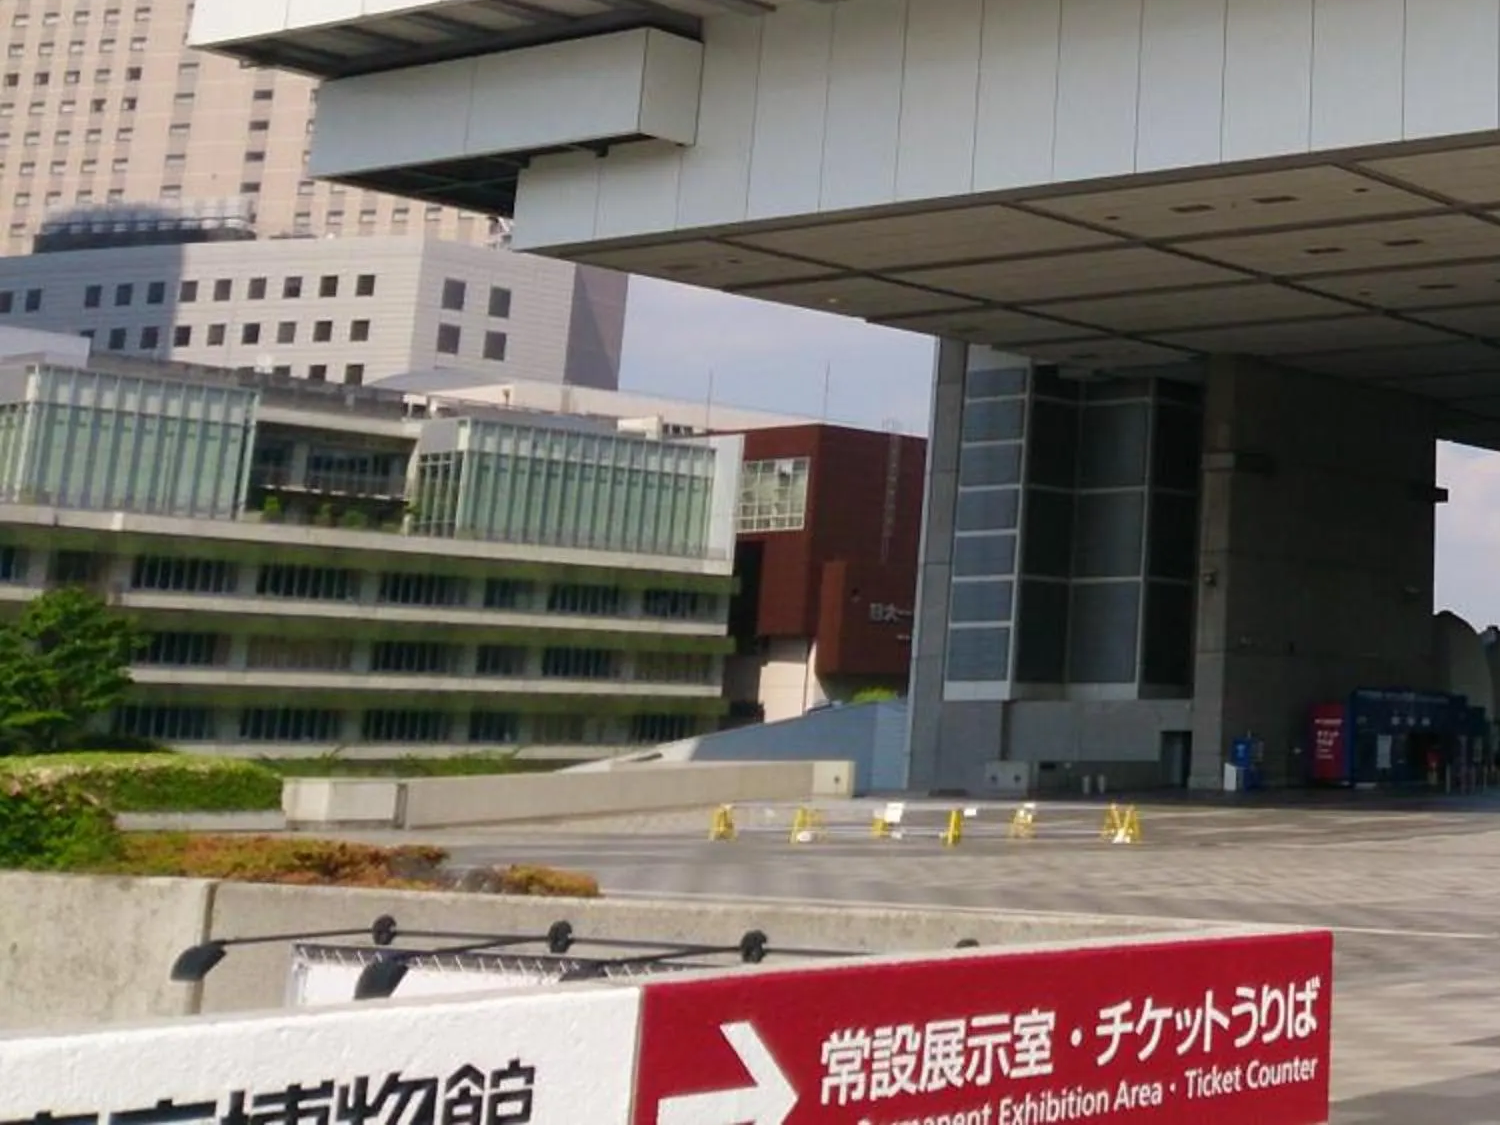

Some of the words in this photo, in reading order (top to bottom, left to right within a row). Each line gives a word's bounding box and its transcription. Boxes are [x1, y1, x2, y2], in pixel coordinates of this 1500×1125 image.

[998, 1084, 1110, 1125] Exhibition
[1113, 1079, 1163, 1112] Area
[1184, 1065, 1242, 1100] Ticket
[1246, 1056, 1319, 1089] Counter
